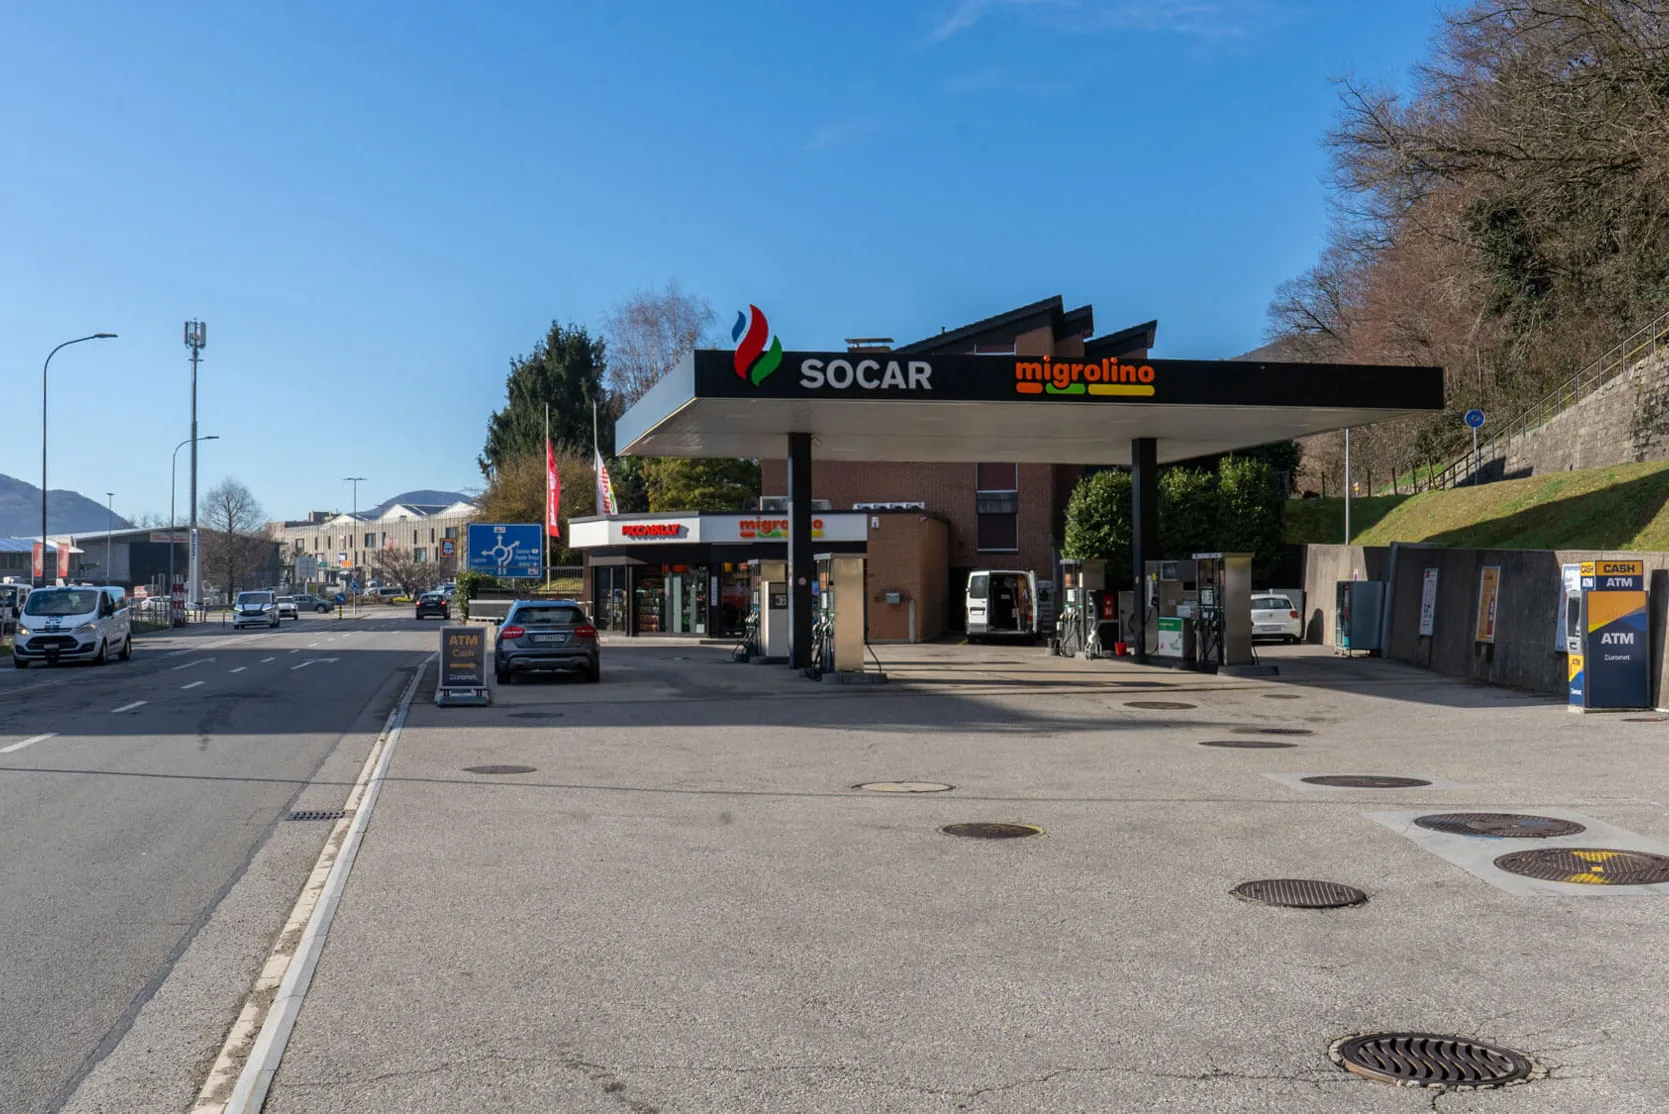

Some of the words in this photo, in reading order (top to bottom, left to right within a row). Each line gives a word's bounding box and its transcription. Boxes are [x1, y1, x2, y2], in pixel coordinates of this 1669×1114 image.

[800, 359, 932, 390] SOCAR
[1015, 354, 1155, 389] migrolino
[622, 524, 680, 537] PICCADILLY
[739, 515, 824, 535] migroo
[1603, 564, 1635, 573] CASH
[1606, 577, 1633, 587] ATM
[449, 635, 478, 645] ATM
[1601, 632, 1634, 645] ATM
[453, 649, 474, 657] Cash
